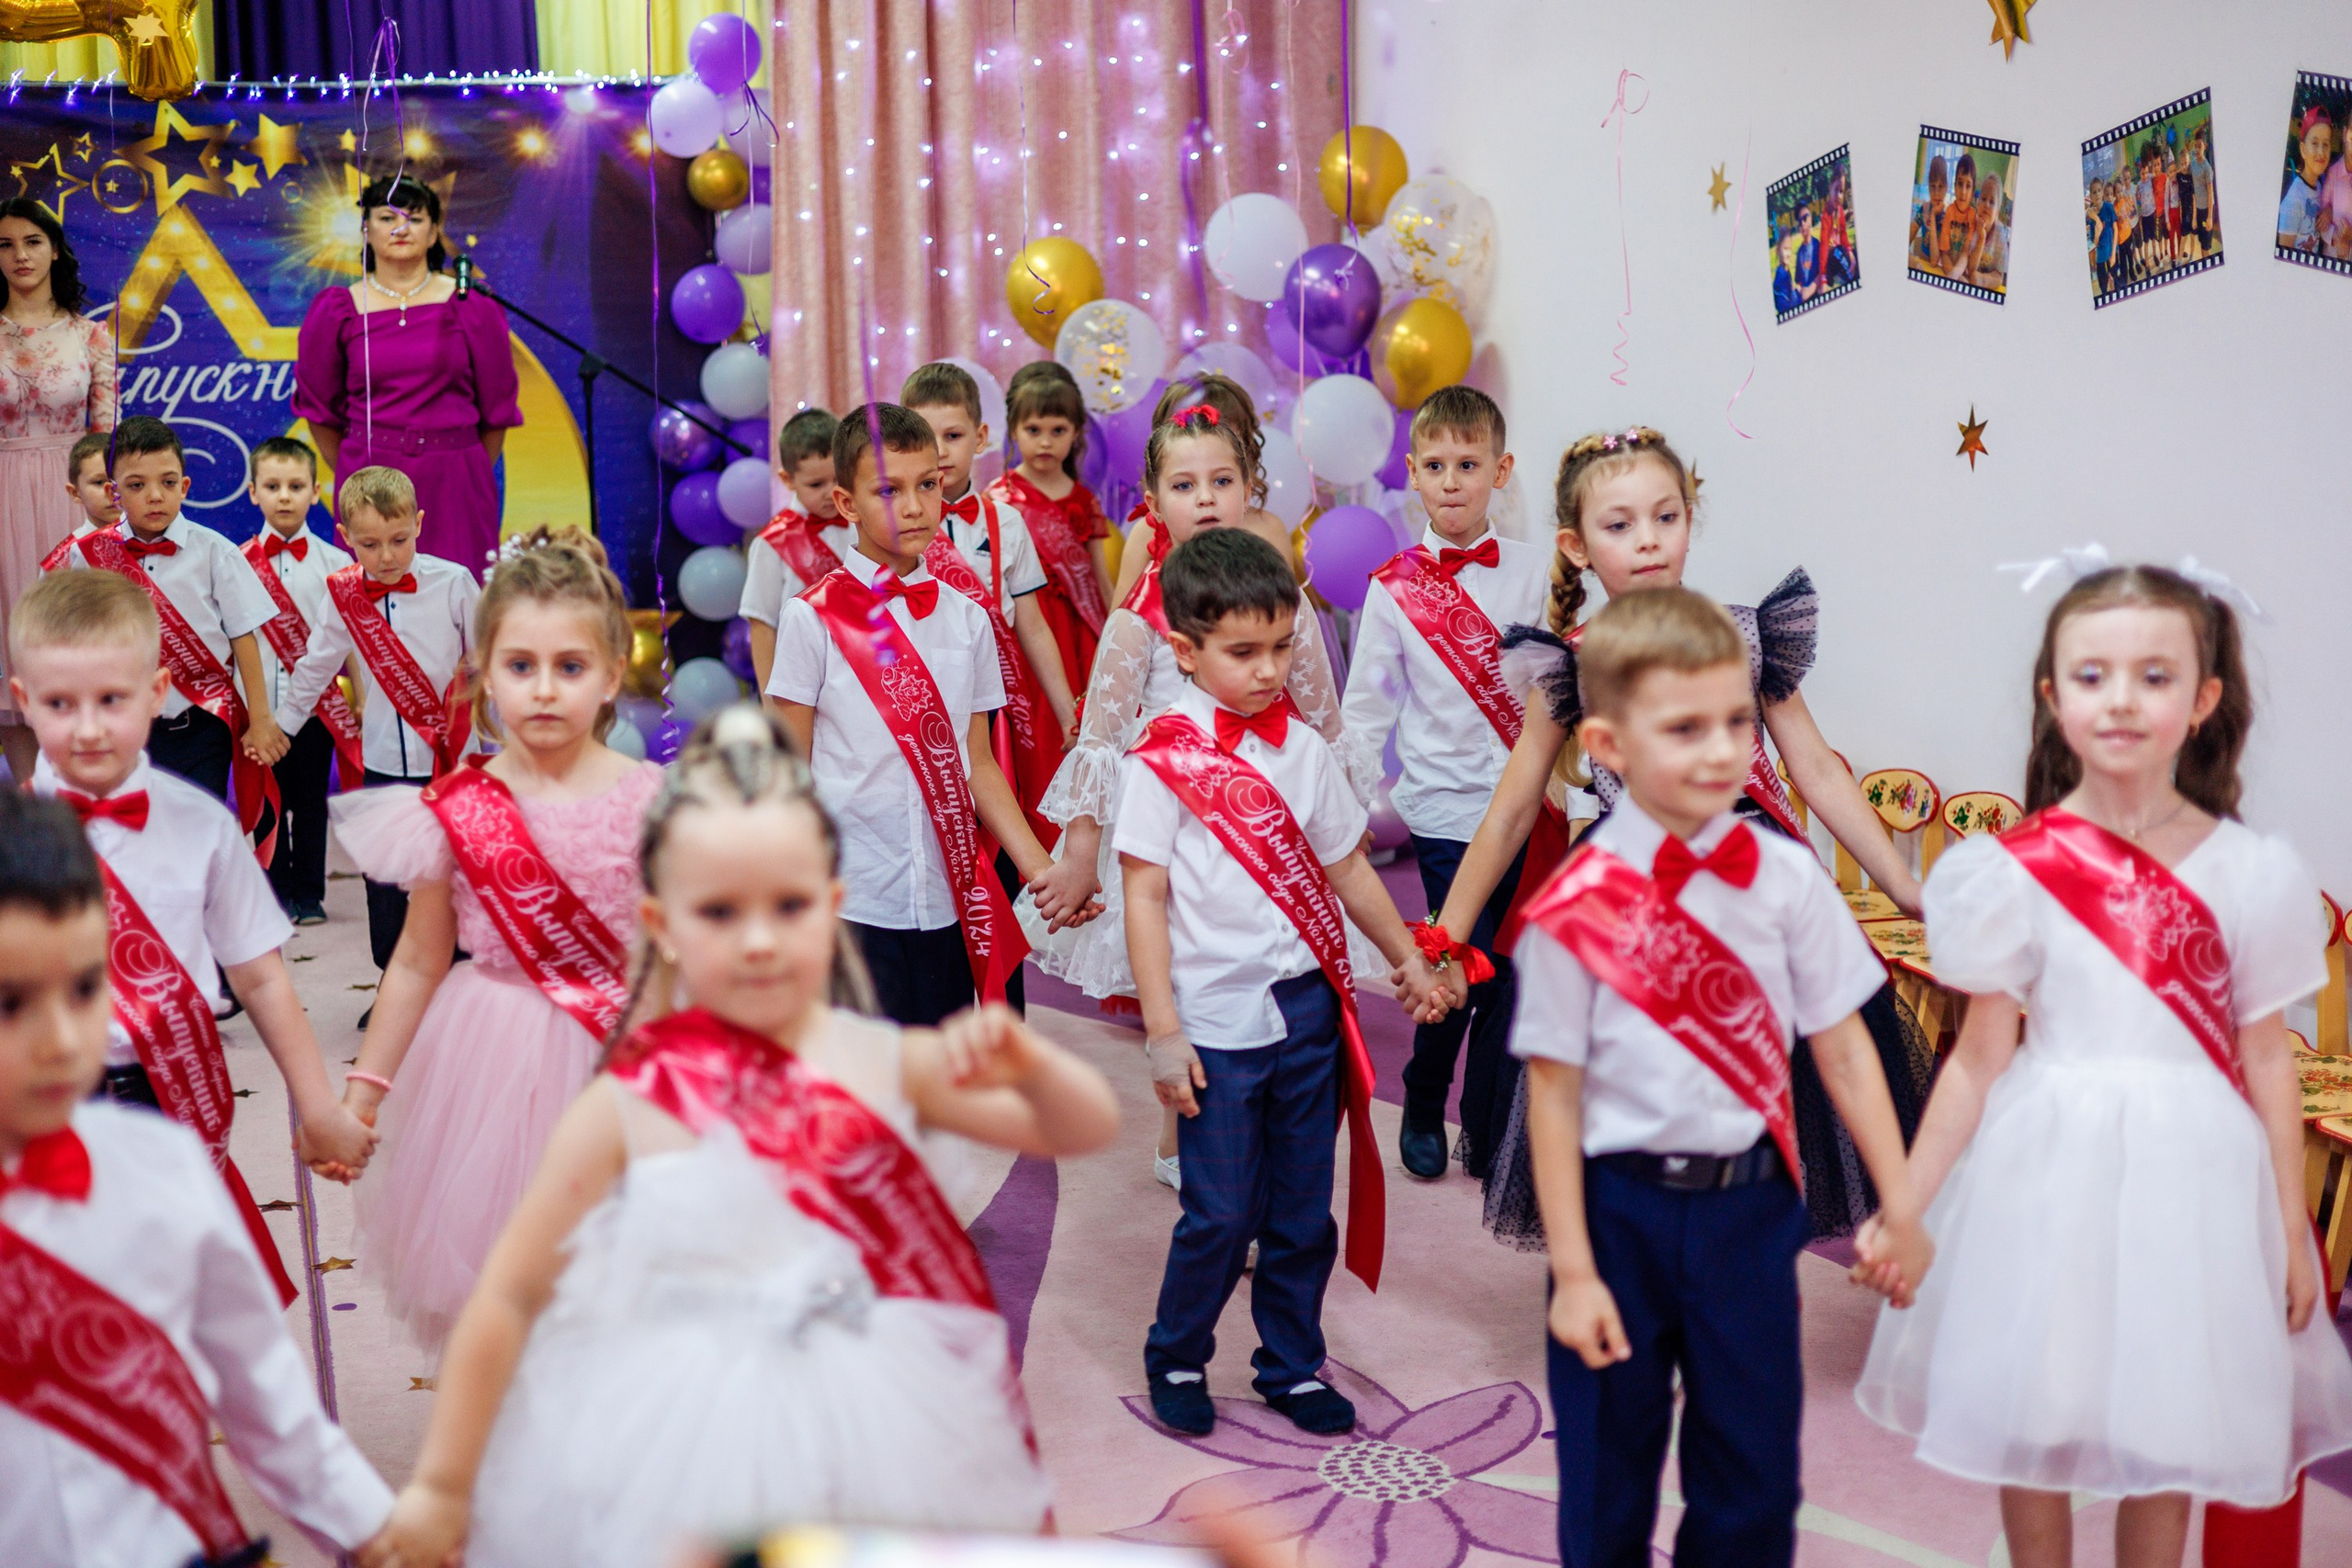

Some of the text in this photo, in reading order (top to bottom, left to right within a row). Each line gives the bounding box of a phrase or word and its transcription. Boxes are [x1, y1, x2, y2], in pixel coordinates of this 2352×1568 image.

[341, 610, 370, 656] детского
[370, 655, 388, 681] сада
[350, 593, 435, 710] Выпускник
[1428, 632, 1477, 684] детского
[1476, 684, 1499, 712] сада
[1007, 694, 1035, 750] 2024
[898, 733, 961, 874] детского сада №4
[920, 711, 994, 957] Выпускник 2024
[966, 811, 977, 856] Артём
[1203, 811, 1324, 946] детского сада №4
[1226, 776, 1344, 949] Выпускник
[1295, 834, 1340, 918] Цымбал Иван
[477, 885, 538, 960] детского
[493, 844, 631, 1008] Выпускни
[108, 981, 155, 1042] тского
[148, 1039, 174, 1084] сада
[111, 930, 222, 1133] Выпускник
[208, 1051, 229, 1104] Кирилл
